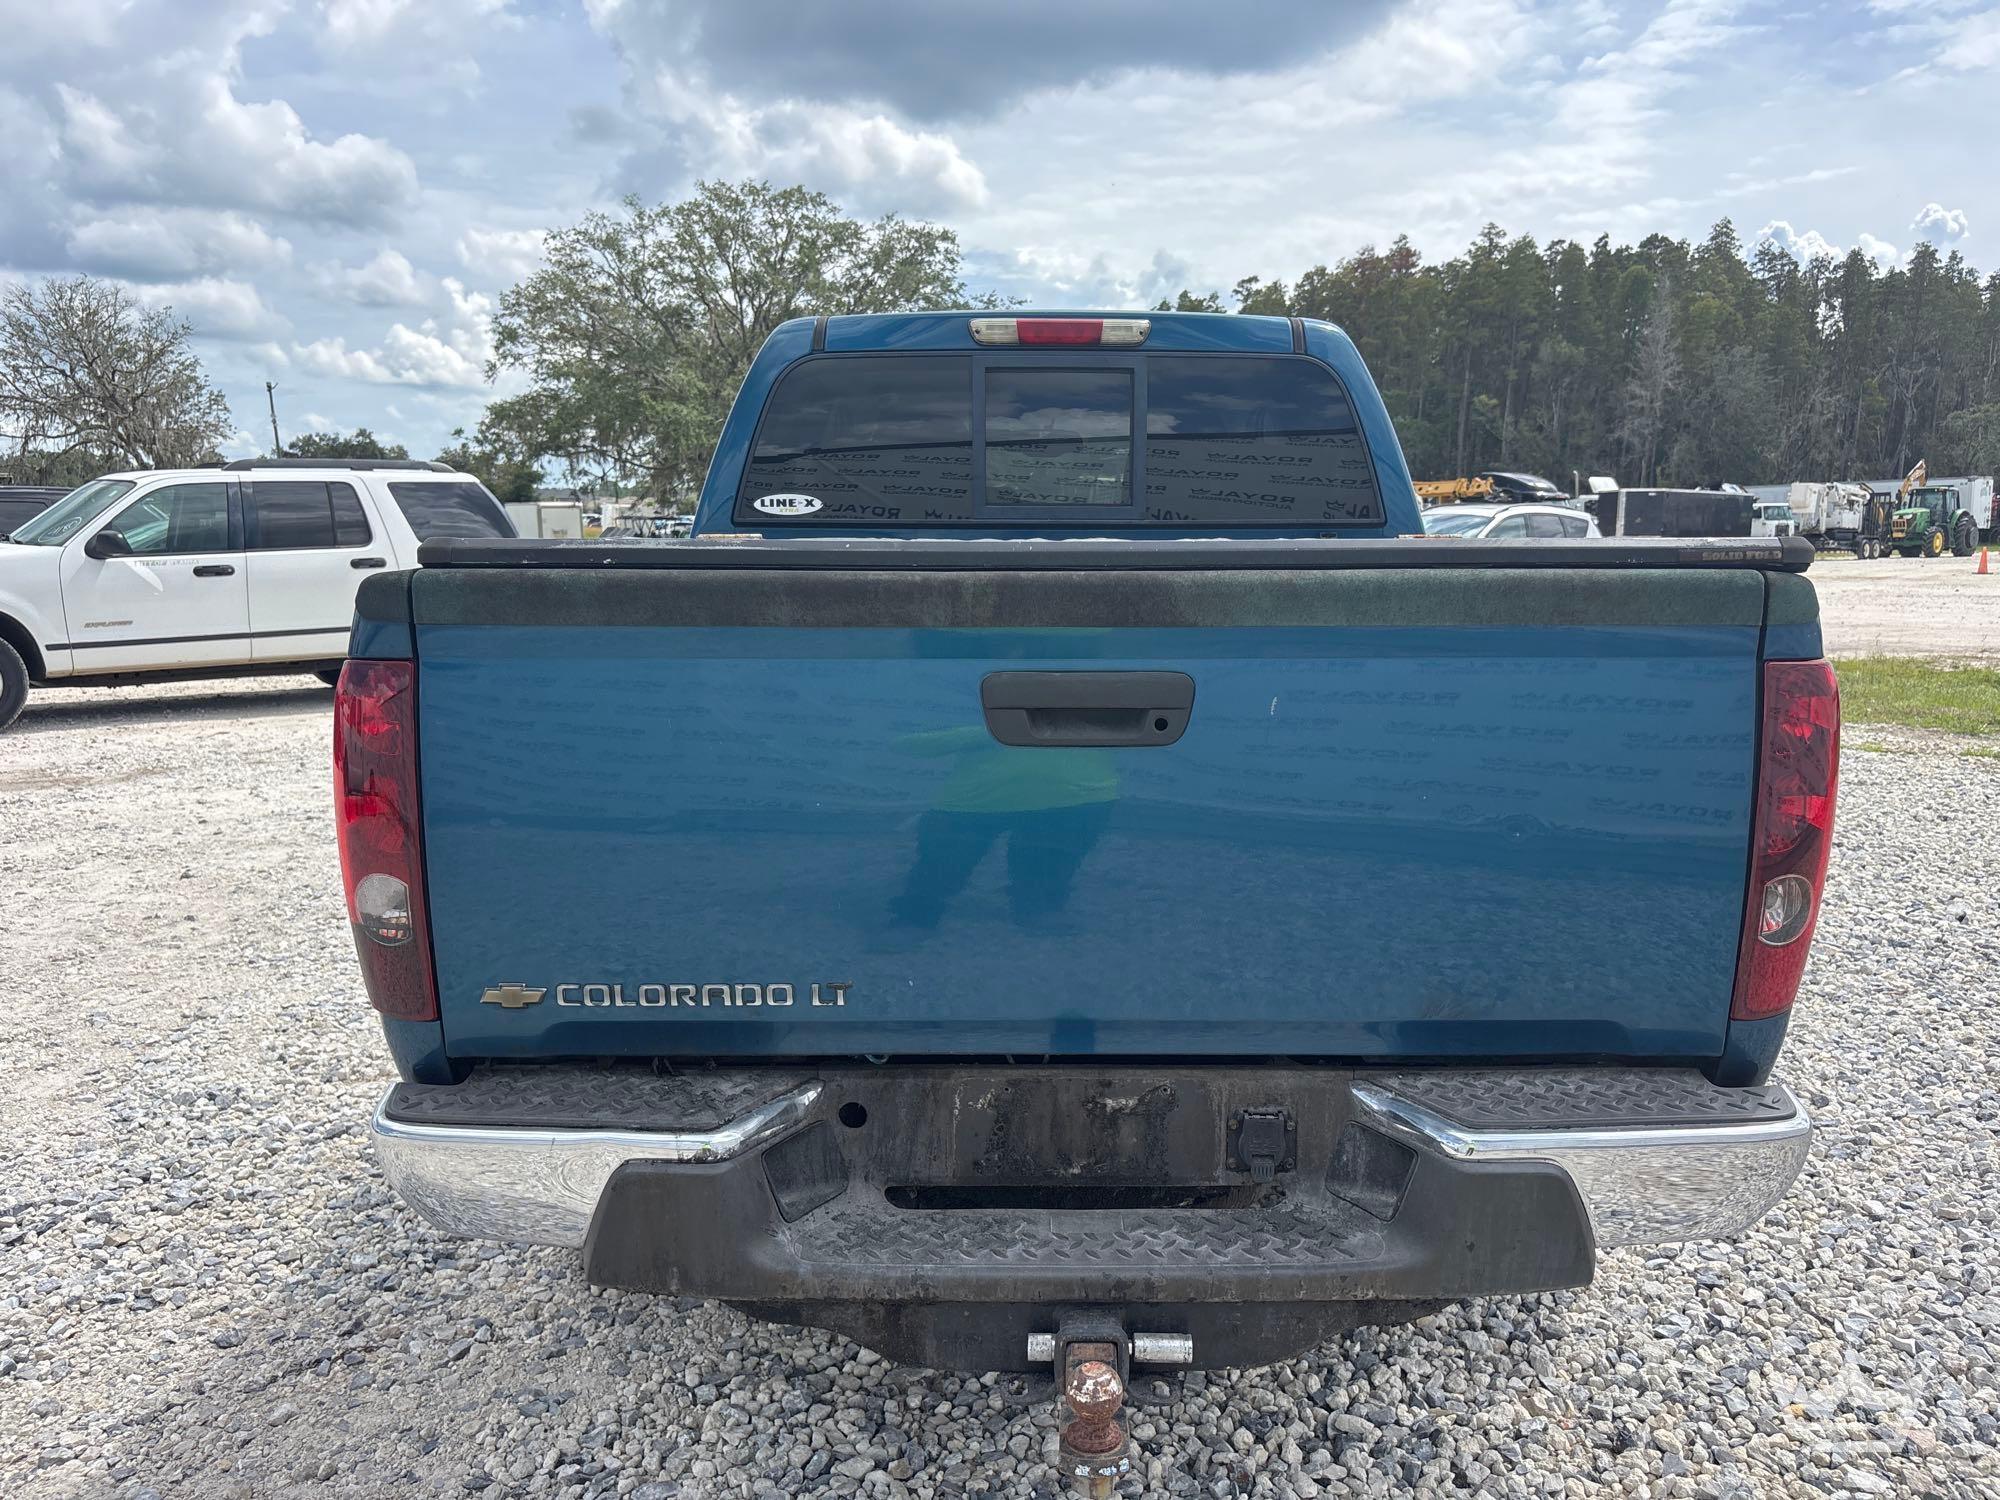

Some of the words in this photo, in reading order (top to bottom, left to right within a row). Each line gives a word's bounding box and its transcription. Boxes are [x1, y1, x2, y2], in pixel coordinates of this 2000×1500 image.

[760, 498, 816, 508] LINE-X
[1702, 551, 1744, 560] SOLID
[556, 983, 793, 1007] COLORADO
[811, 982, 853, 1006] LT
